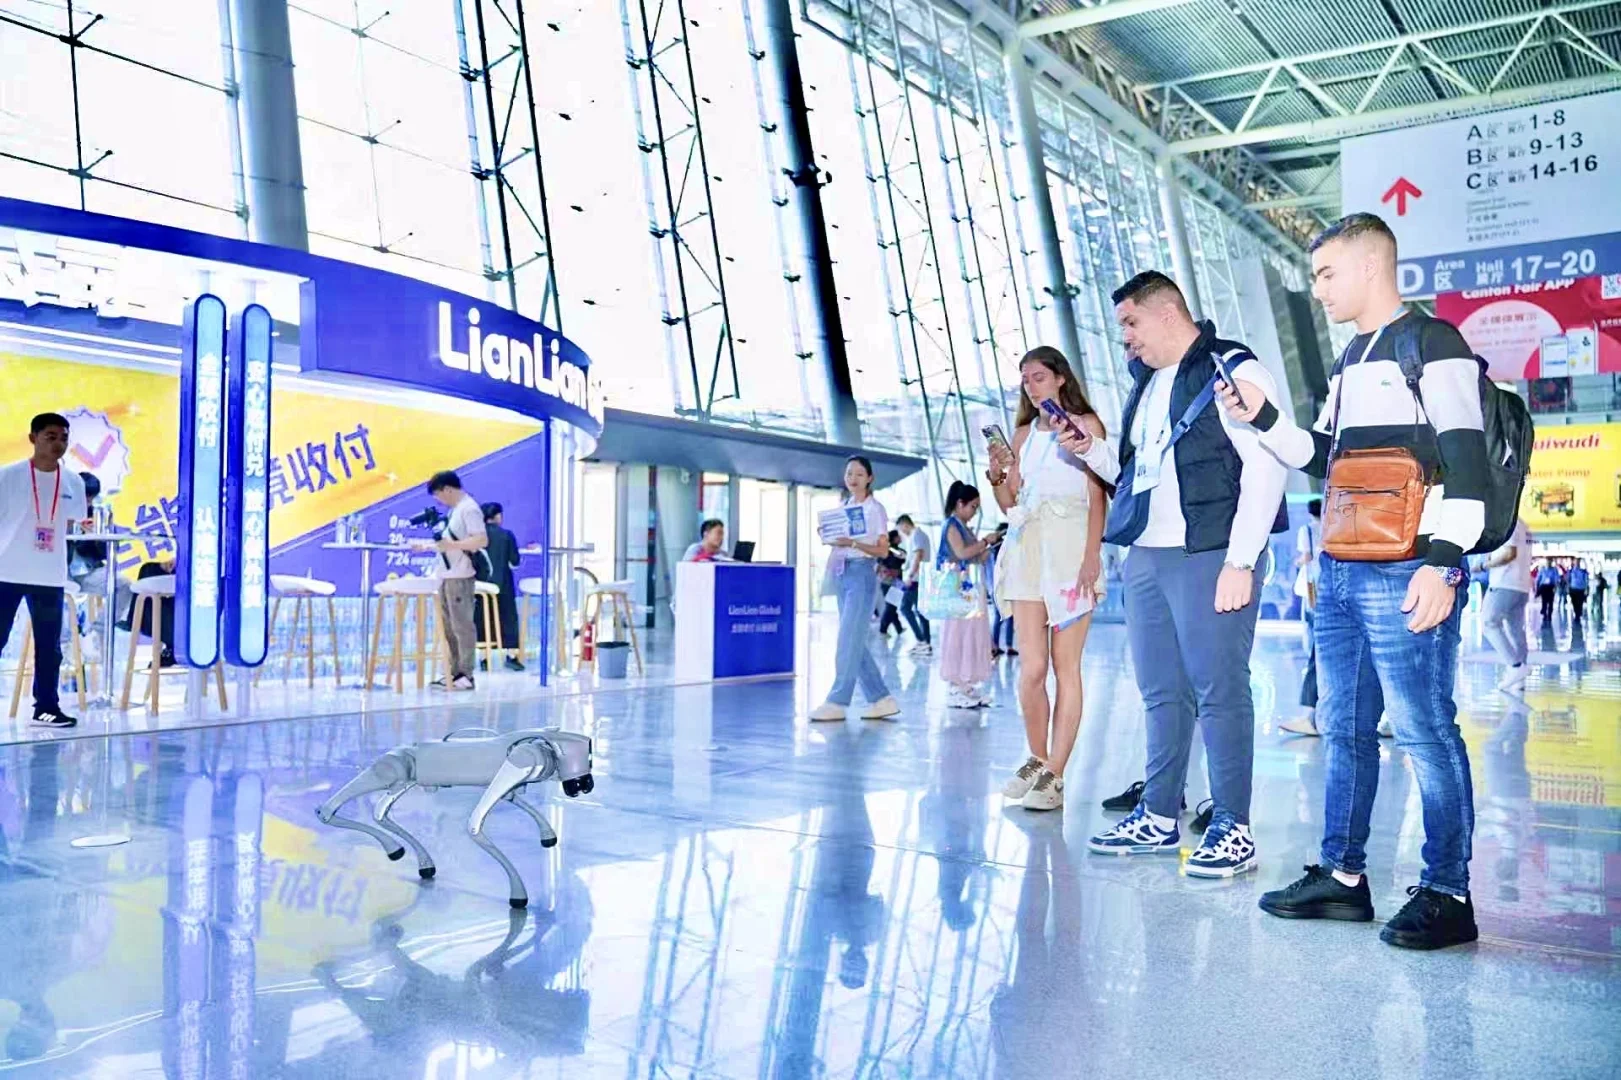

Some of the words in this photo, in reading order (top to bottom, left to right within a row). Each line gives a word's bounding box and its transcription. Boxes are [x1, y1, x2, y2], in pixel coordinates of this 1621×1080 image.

[1467, 125, 1483, 141] A
[1529, 109, 1566, 130] 1-8
[1467, 149, 1483, 165] B
[1530, 131, 1583, 155] 9-13
[1466, 172, 1482, 190] C
[1529, 154, 1598, 180] 14-16
[1398, 263, 1424, 295] D
[1435, 259, 1465, 272] Area
[1476, 259, 1504, 274] Hall
[1512, 248, 1596, 281] 17-20
[1434, 271, 1454, 291] 区
[438, 300, 587, 410] LianLian
